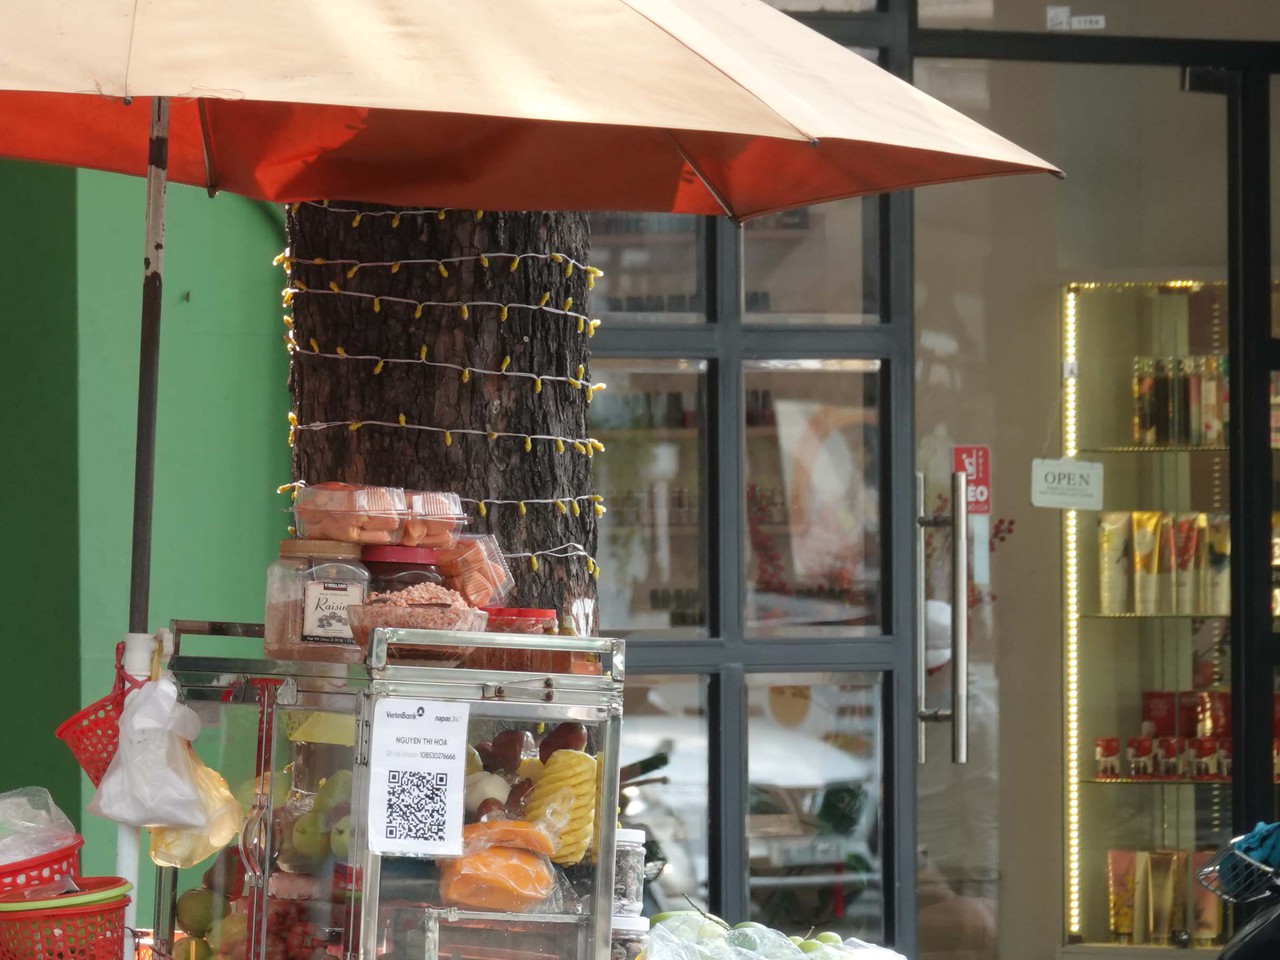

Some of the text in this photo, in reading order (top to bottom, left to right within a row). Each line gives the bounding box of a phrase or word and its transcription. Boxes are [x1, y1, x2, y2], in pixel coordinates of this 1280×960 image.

[1044, 471, 1090, 487] OPEN
[967, 484, 989, 502] ÉO
[386, 711, 417, 720] VietinBank
[434, 716, 451, 724] napas
[395, 737, 421, 745] NGUYEN
[423, 738, 433, 746] THI
